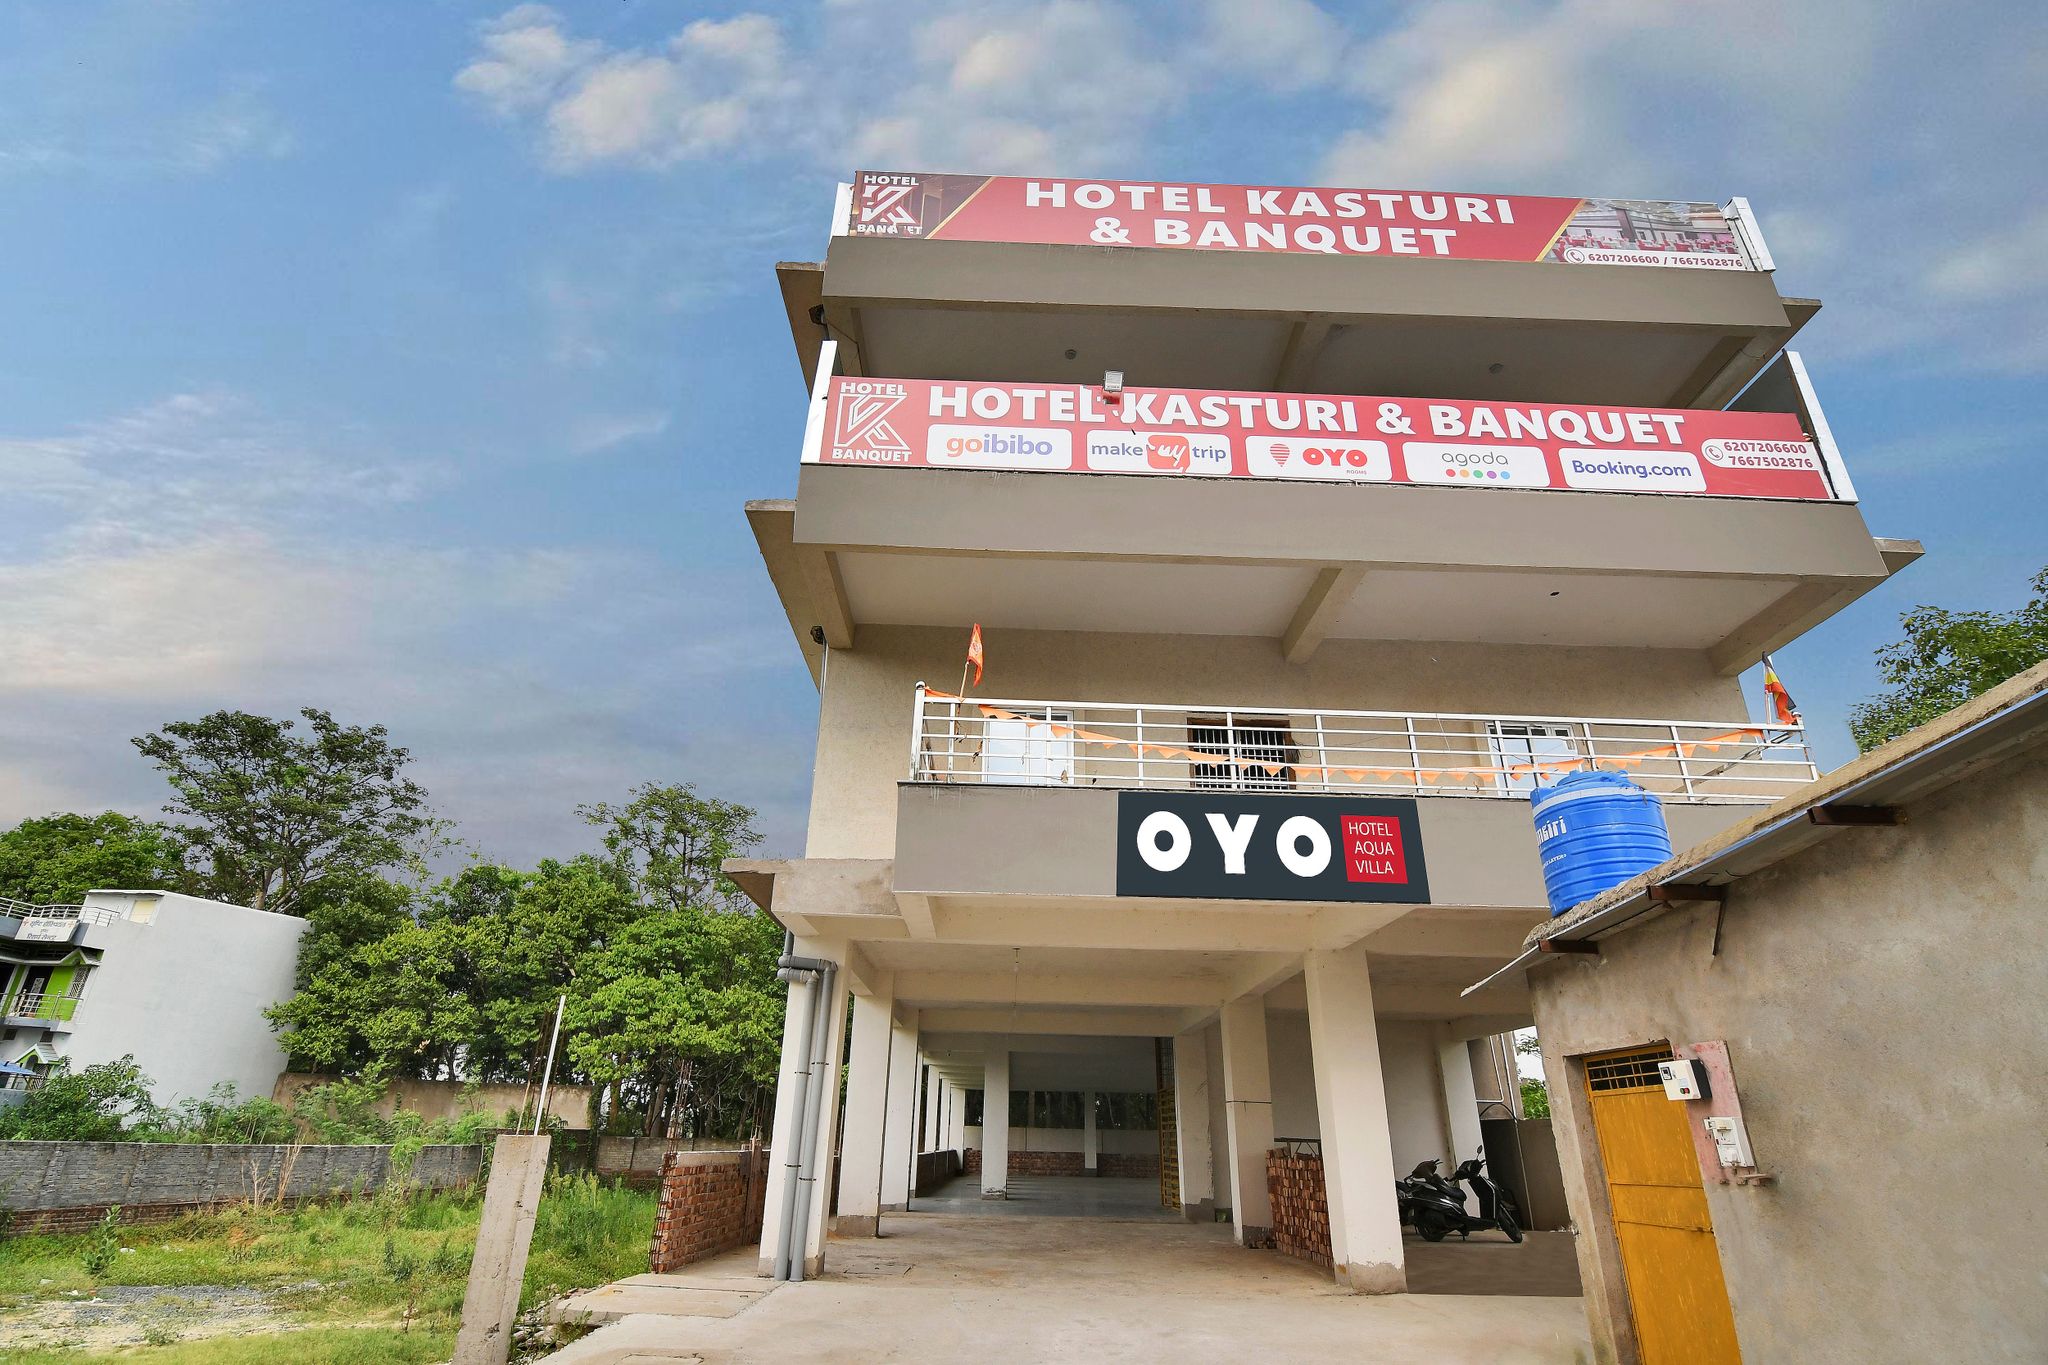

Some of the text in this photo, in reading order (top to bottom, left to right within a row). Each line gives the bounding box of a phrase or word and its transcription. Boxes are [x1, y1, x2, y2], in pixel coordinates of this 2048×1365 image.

[864, 175, 919, 186] HOTEL
[1026, 182, 1515, 224] HOTEL KASTURI
[1089, 216, 1457, 255] & BANQUET
[1588, 253, 1660, 264] 6207206600
[1671, 256, 1743, 268] 7667502876
[840, 382, 908, 395] HOTEL
[929, 385, 1685, 446] HOTEL KASTURI & BANQUET
[946, 433, 1053, 457] goibibo
[1091, 442, 1143, 457] make
[1192, 445, 1226, 462] trip
[1724, 441, 1807, 454] 6207206600
[831, 448, 912, 462] BANQUET
[1302, 447, 1368, 467] OYO
[1441, 451, 1509, 467] agoda
[1728, 455, 1813, 468] 7667502876
[1571, 460, 1692, 479] Booking.com
[1349, 821, 1393, 837] HOTEL
[1136, 810, 1332, 878] OYO
[1354, 841, 1395, 857] AQUA
[1355, 859, 1394, 875] VILLA
